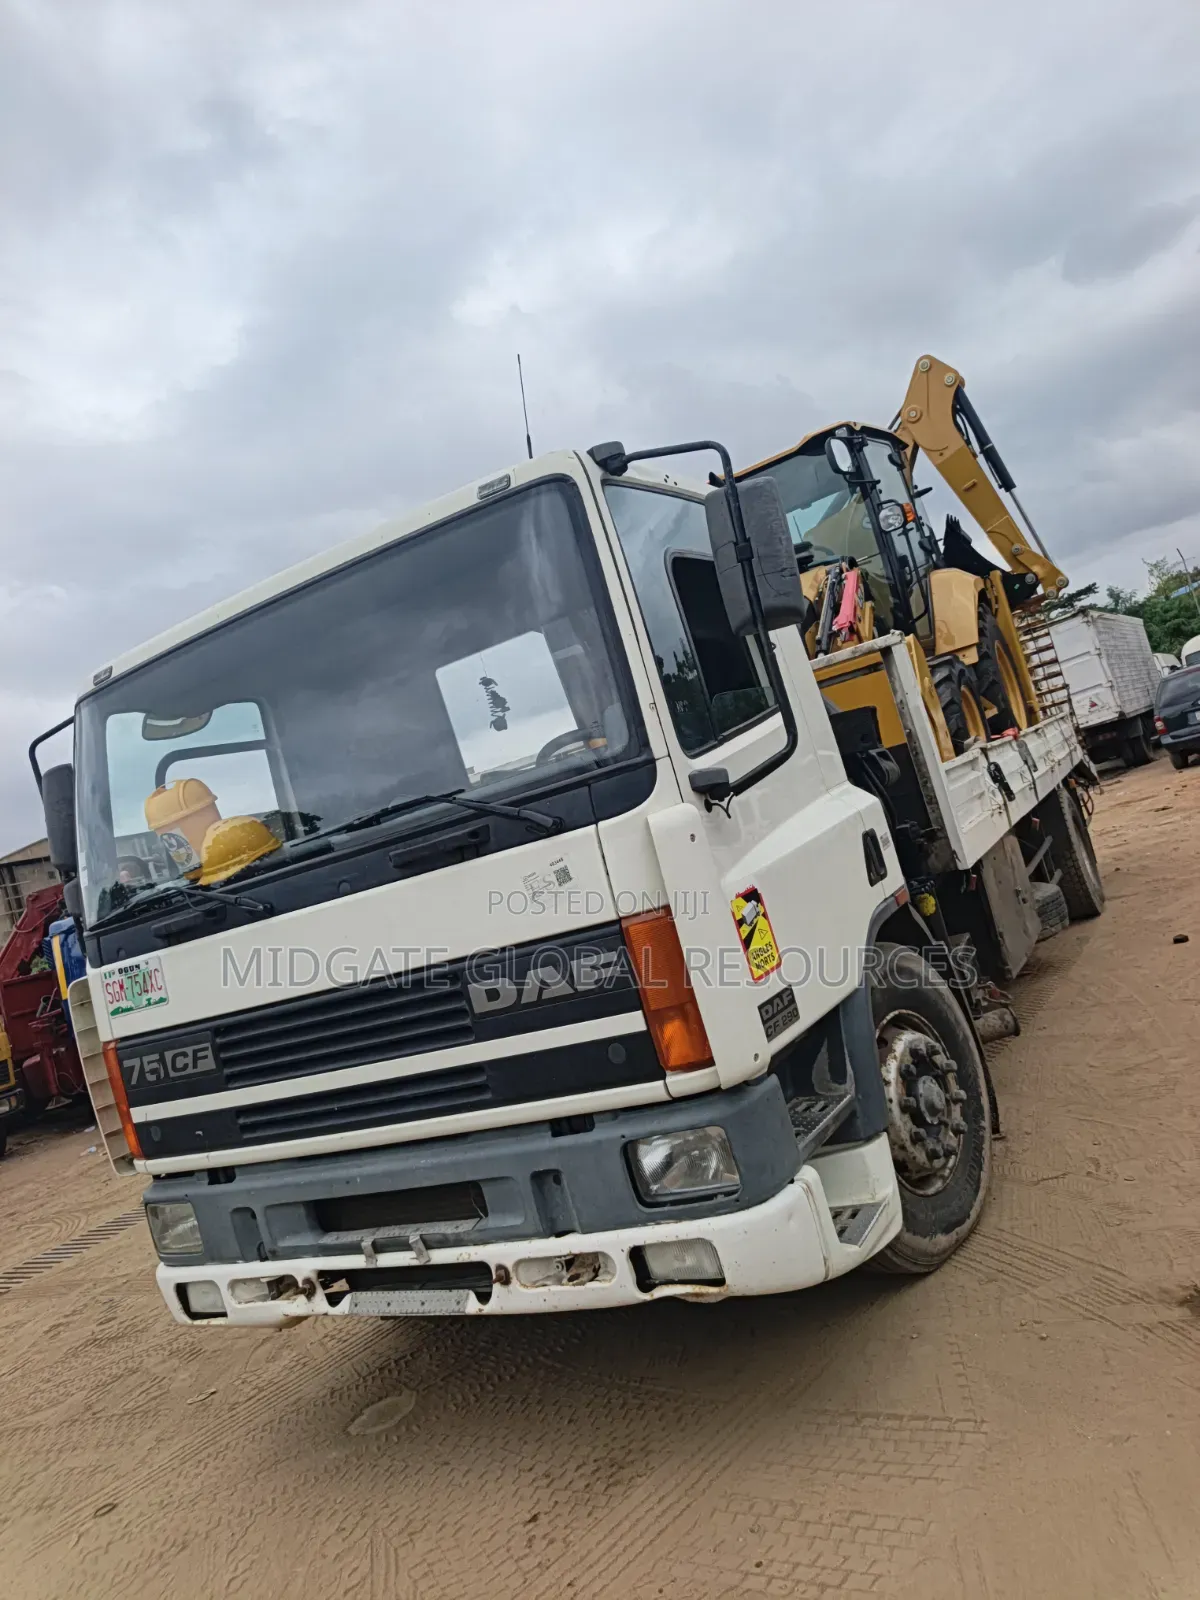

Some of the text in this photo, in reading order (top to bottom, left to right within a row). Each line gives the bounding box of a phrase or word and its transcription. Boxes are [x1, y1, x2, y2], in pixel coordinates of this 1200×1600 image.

[751, 941, 773, 961] ANGLES
[754, 952, 776, 971] MORTS
[117, 963, 141, 975] OGUN
[467, 951, 621, 1014] DAF
[760, 989, 793, 1021] DAF
[765, 1006, 799, 1038] CF 290
